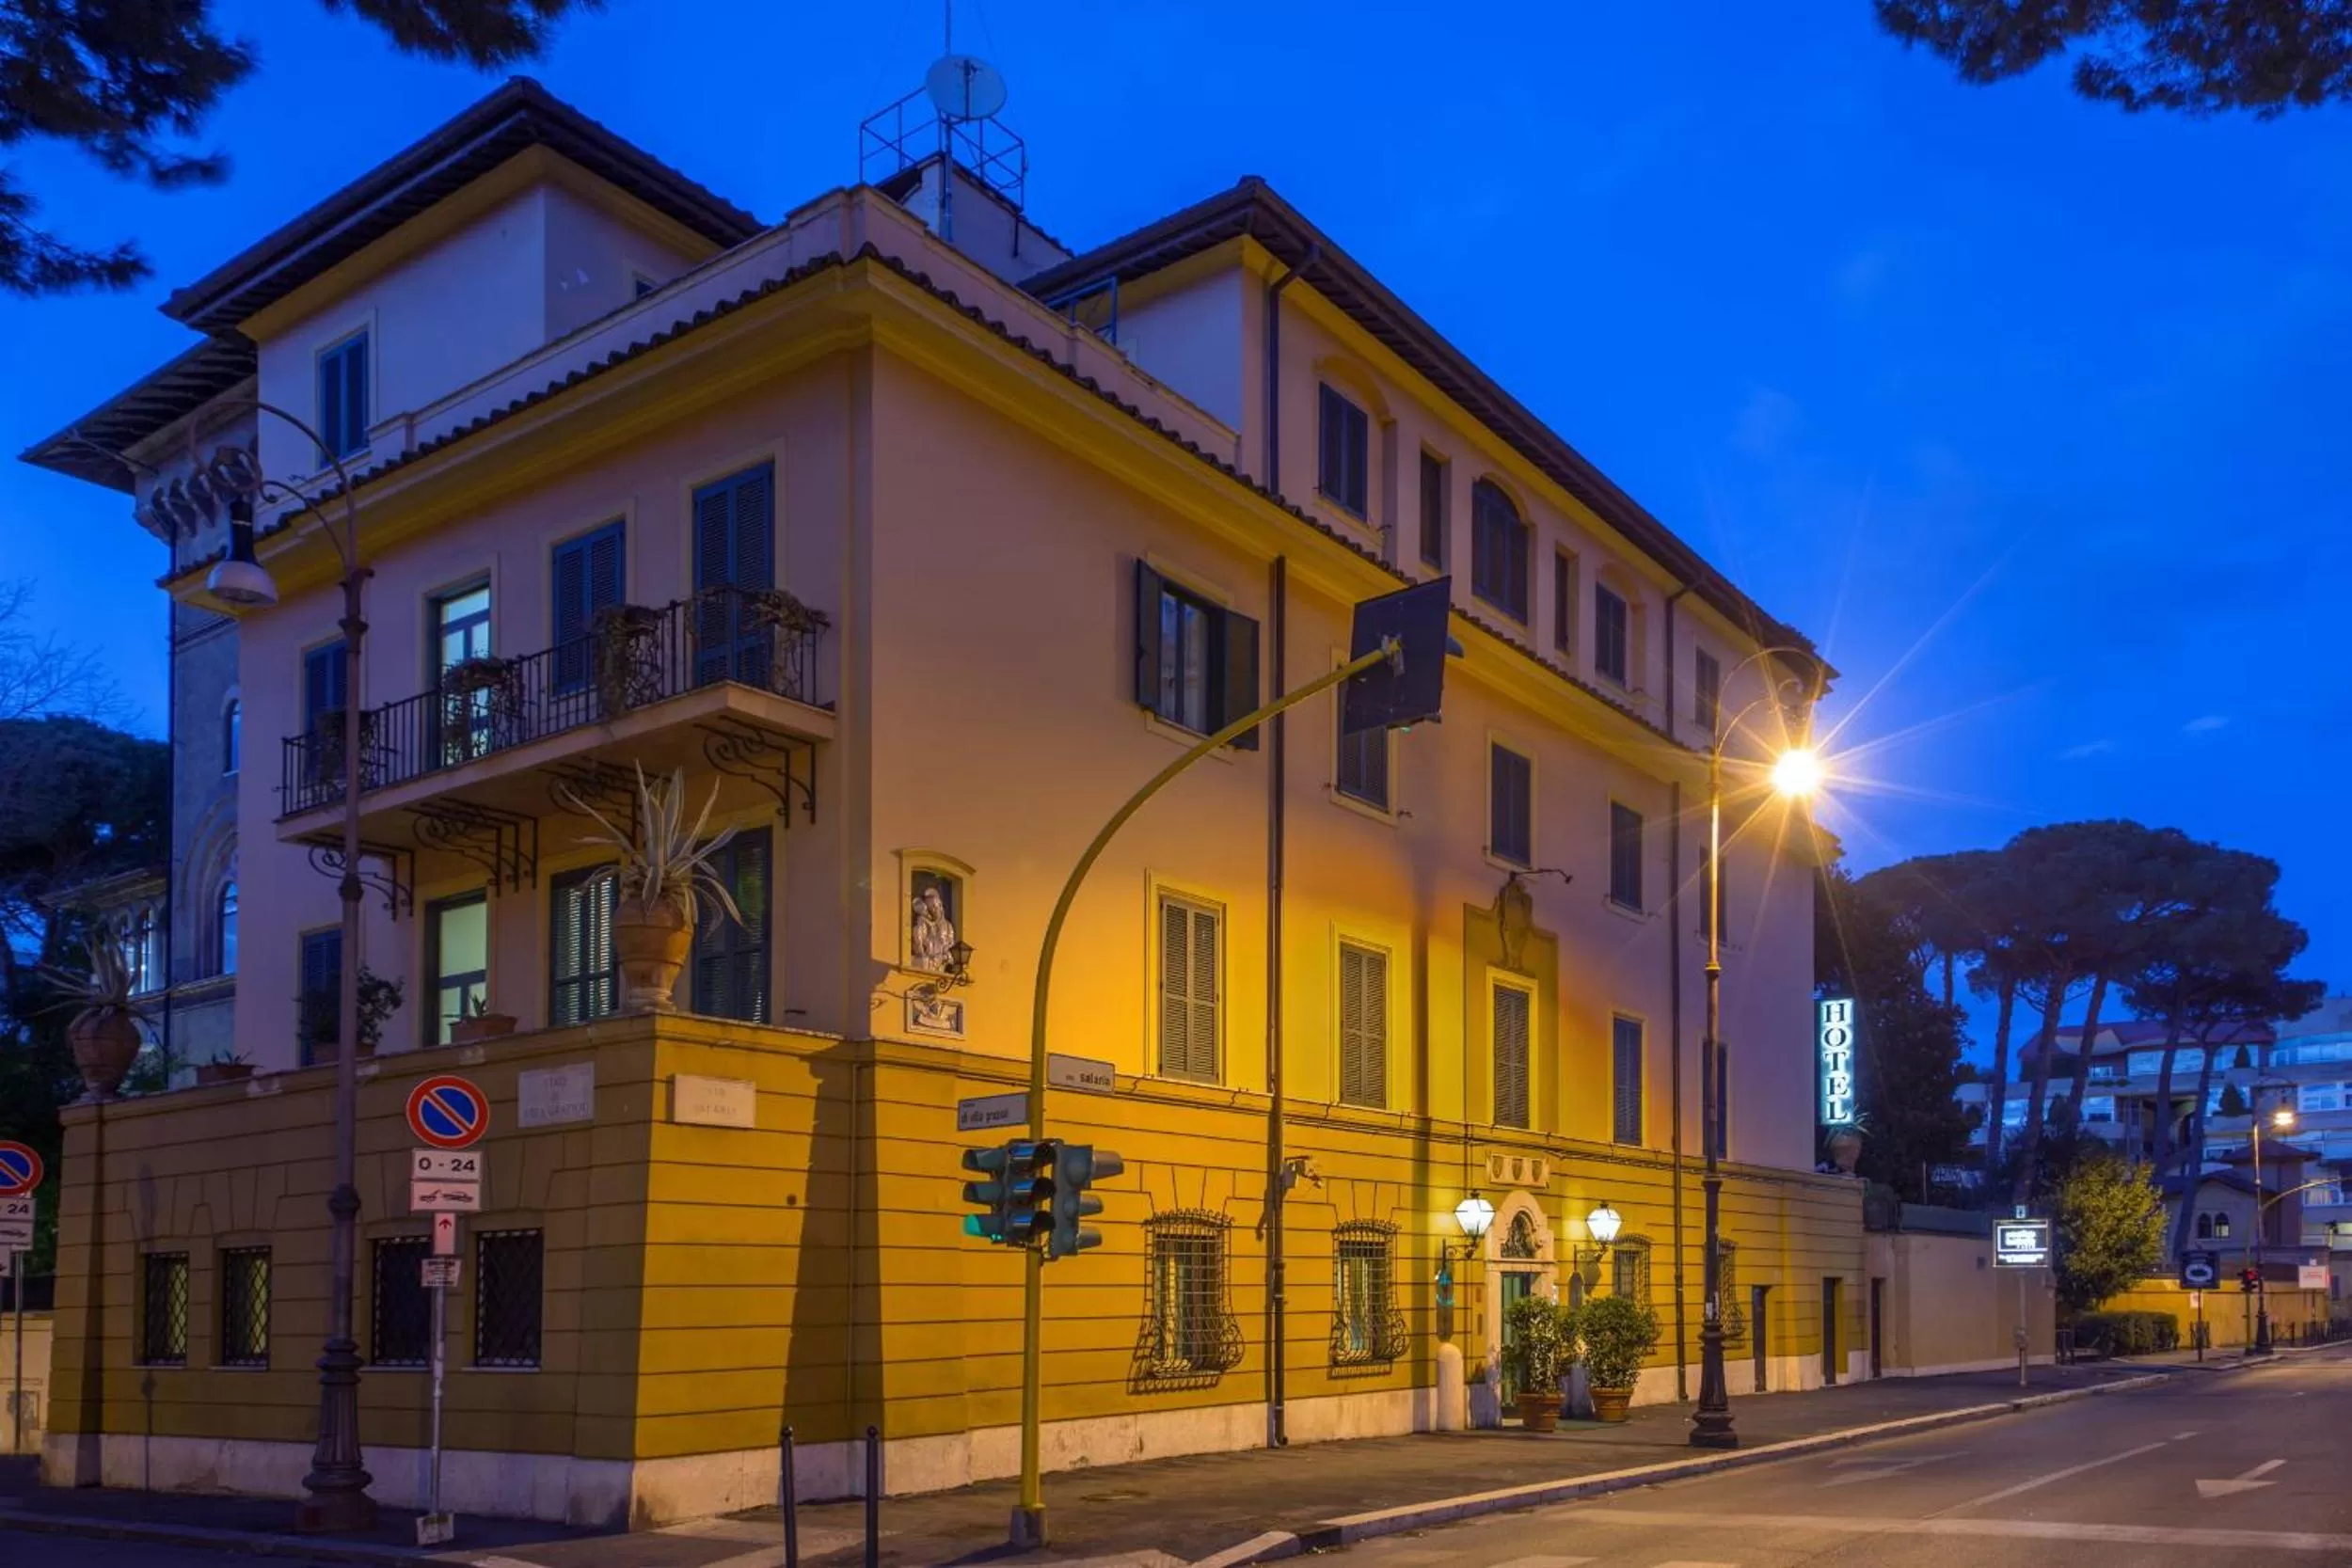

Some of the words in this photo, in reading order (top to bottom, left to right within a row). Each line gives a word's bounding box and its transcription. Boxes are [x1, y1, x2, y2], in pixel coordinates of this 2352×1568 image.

[1824, 1003, 1848, 1120] HOTEL
[419, 1157, 431, 1170] 0
[452, 1159, 474, 1171] 24
[8, 1204, 29, 1214] 24
